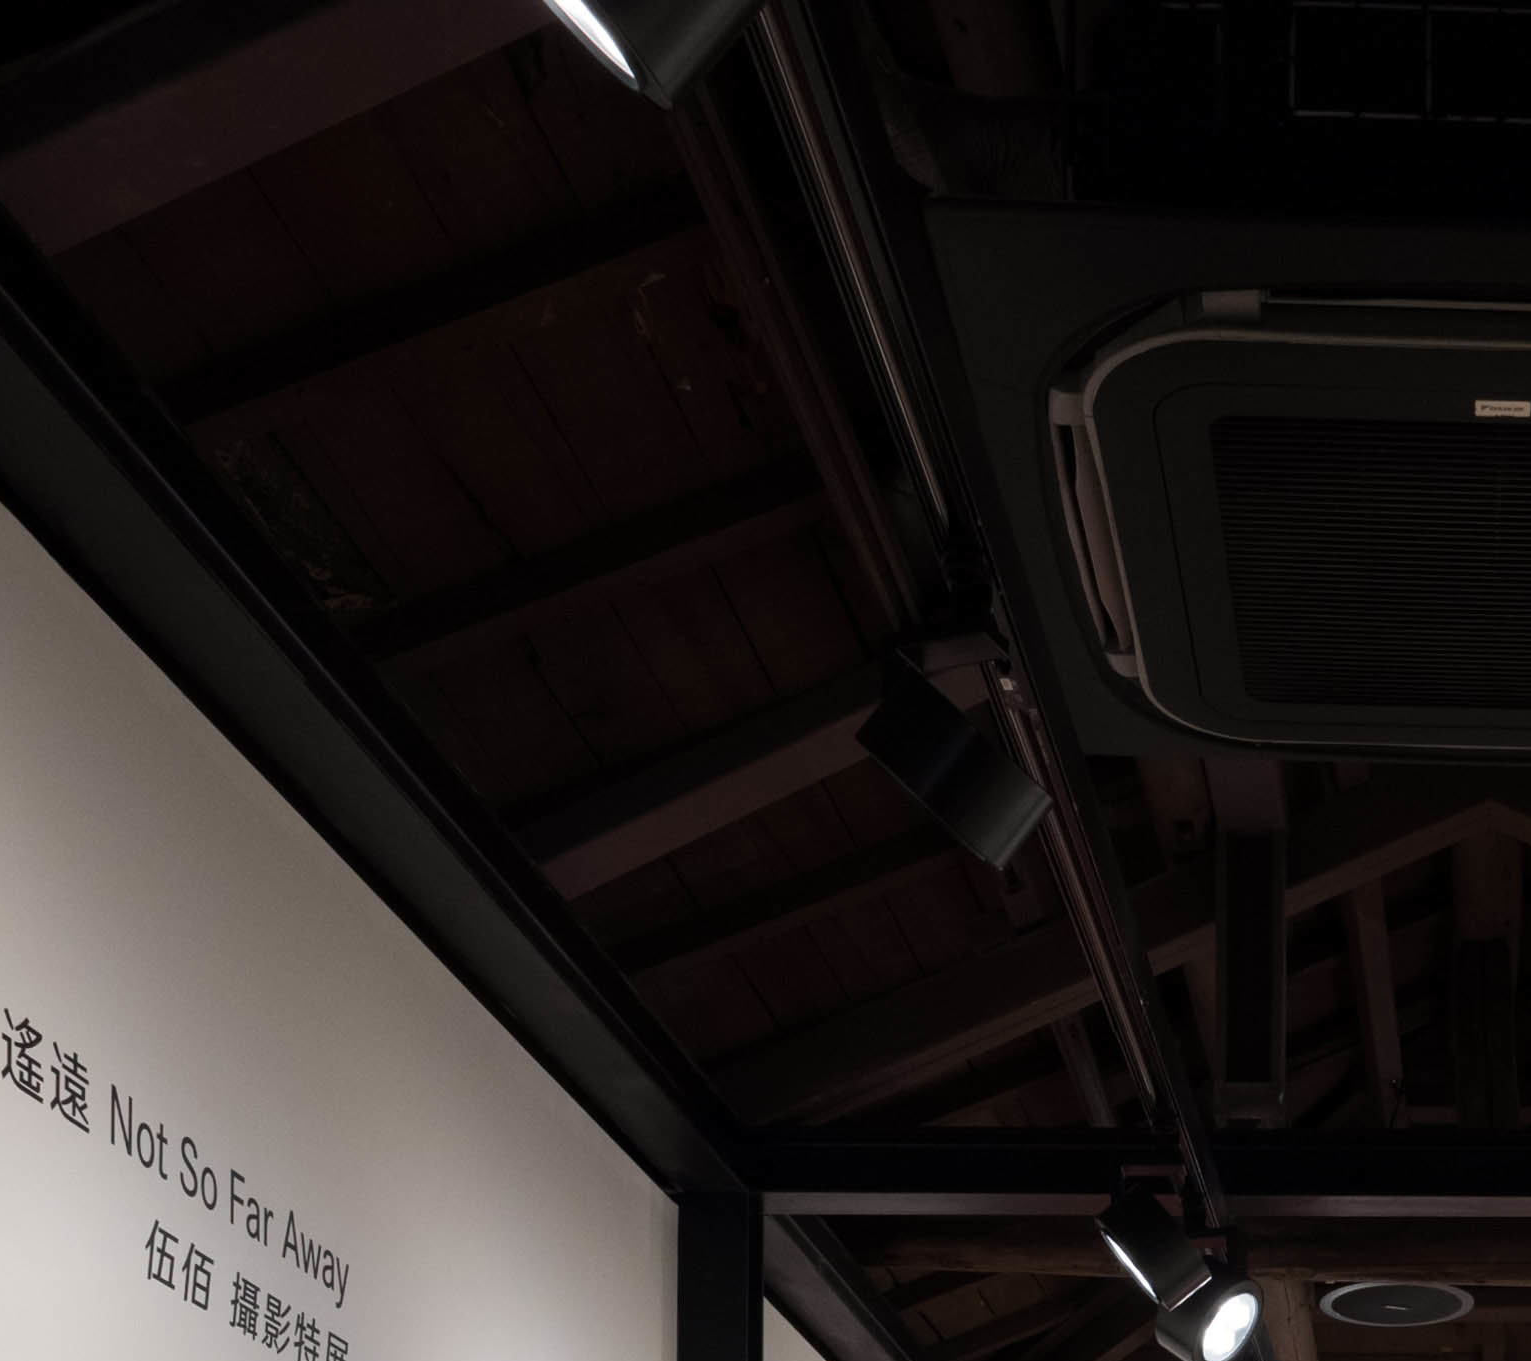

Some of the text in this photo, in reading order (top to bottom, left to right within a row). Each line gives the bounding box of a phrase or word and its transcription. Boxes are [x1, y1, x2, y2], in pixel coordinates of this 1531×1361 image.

[110, 1083, 169, 1181] Not
[179, 1136, 218, 1211] So
[229, 1168, 275, 1247] Far
[281, 1209, 350, 1310] Away
[144, 1218, 215, 1311] 伍佰
